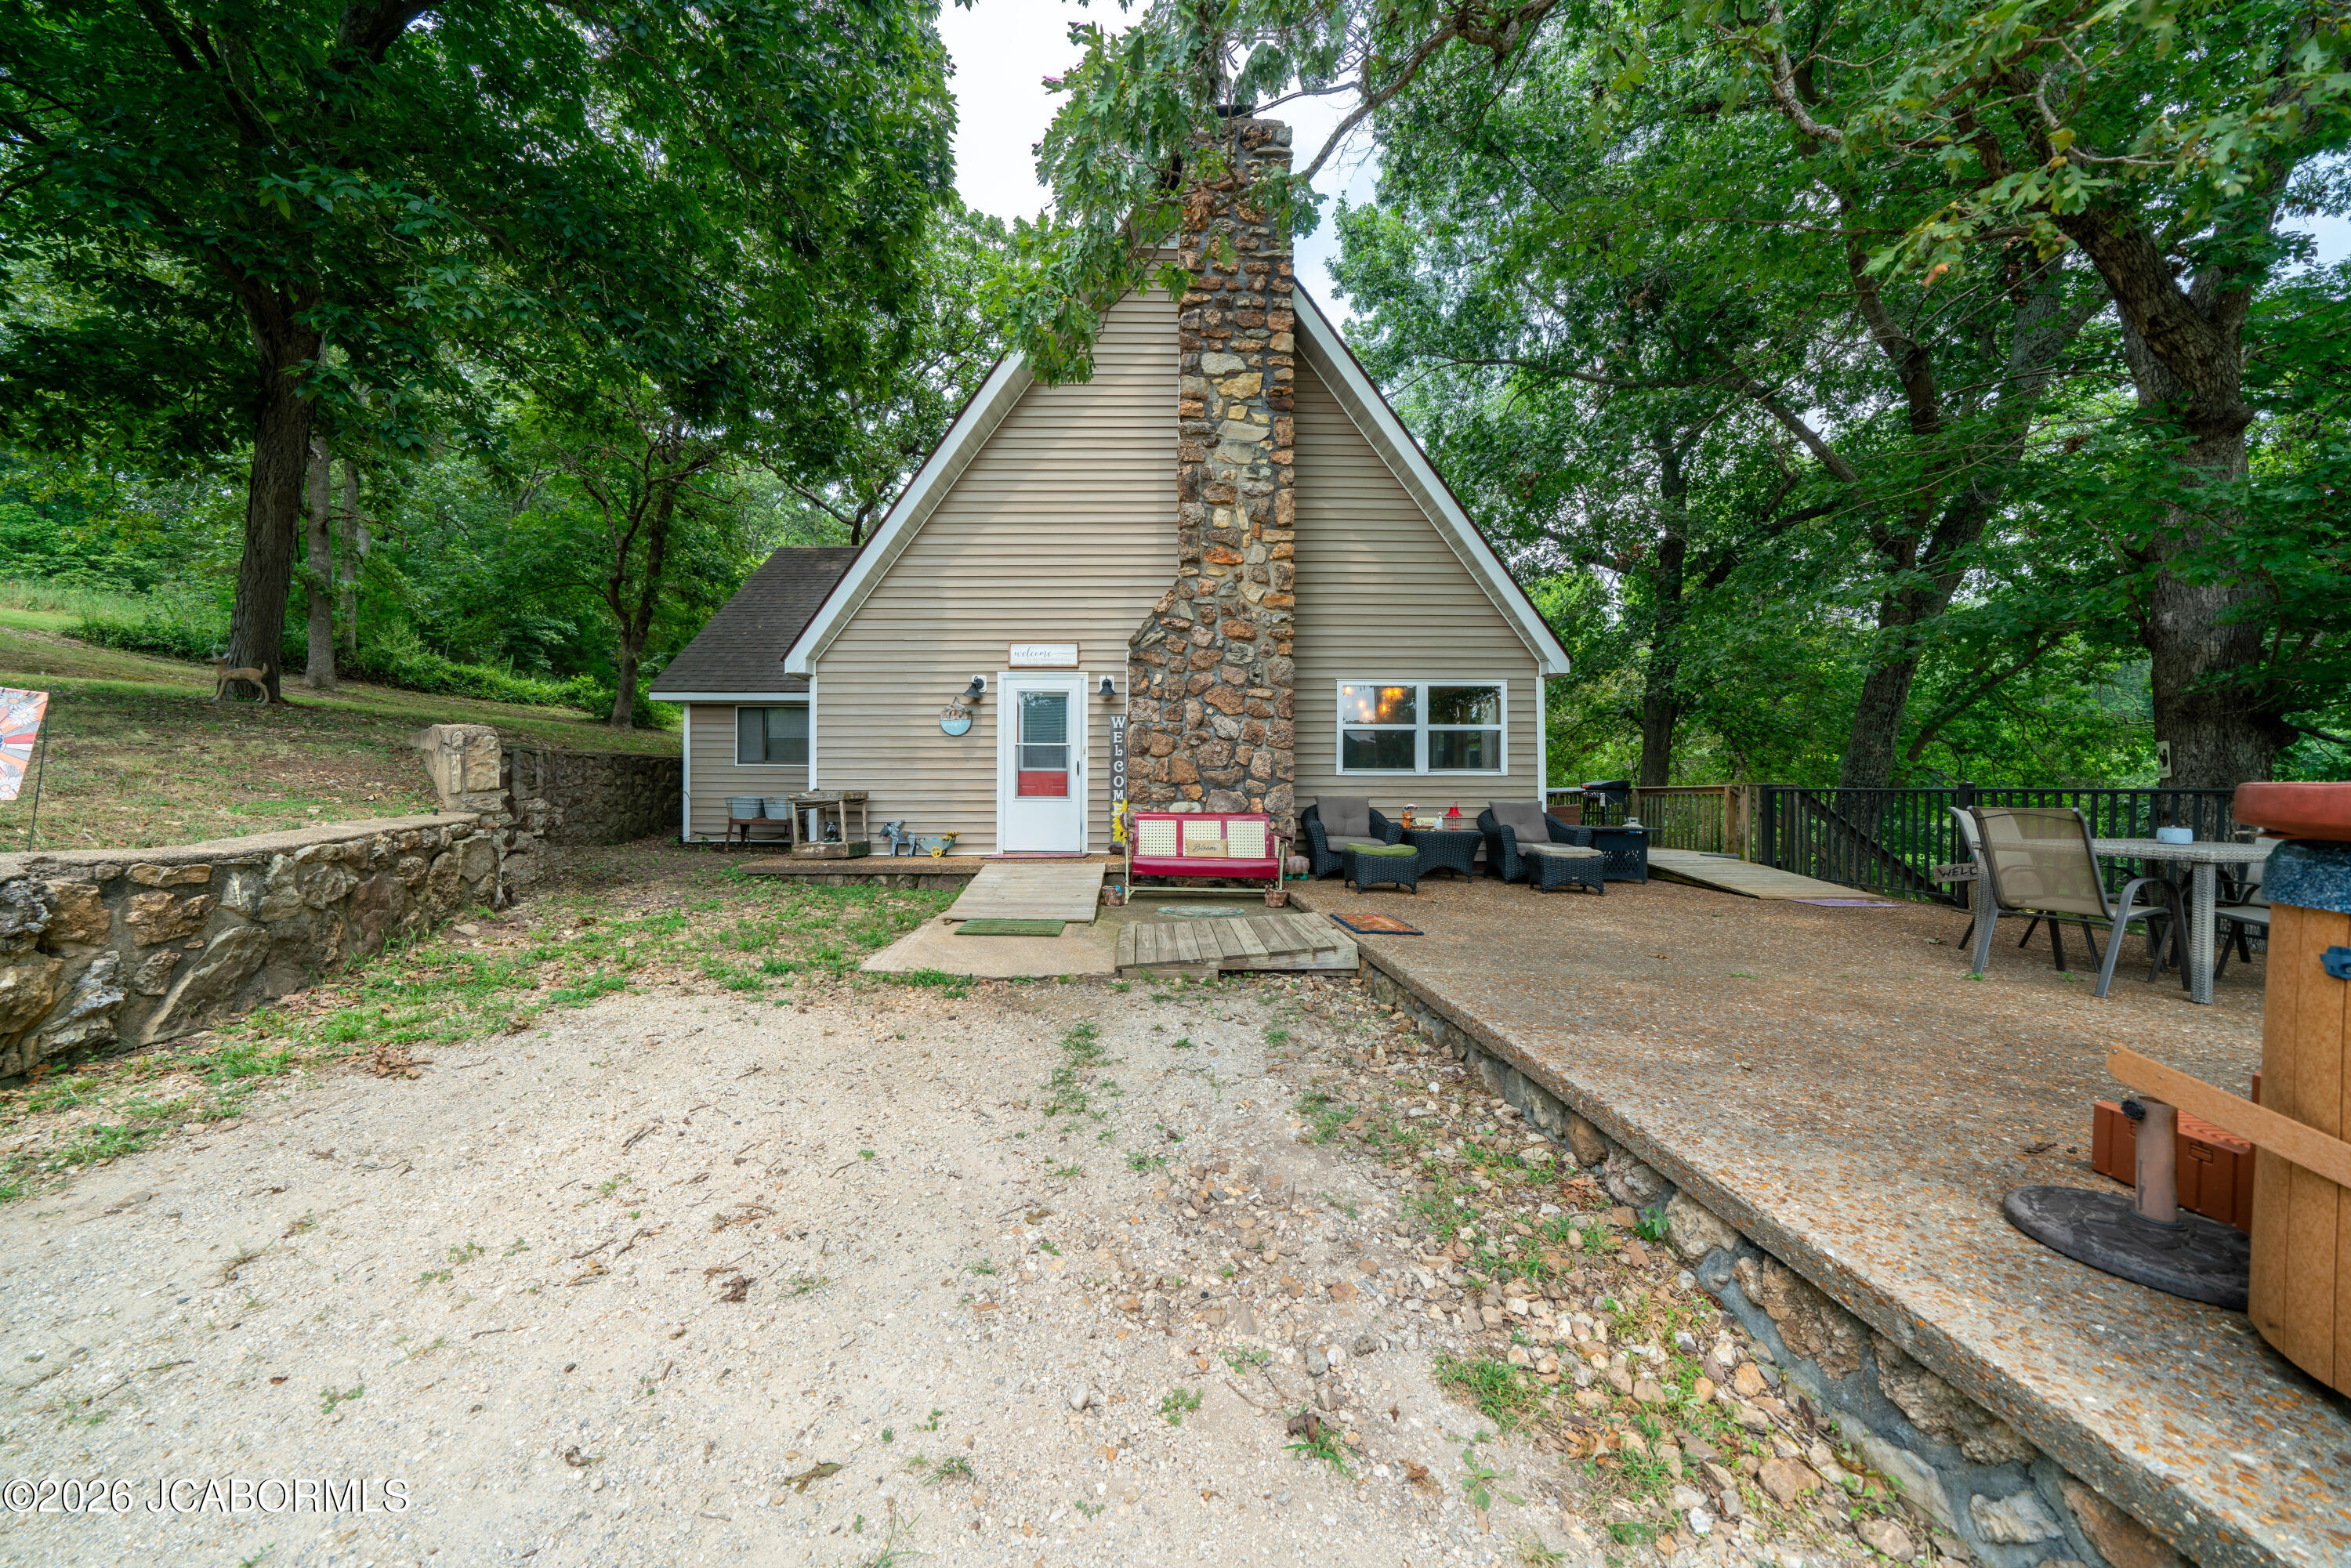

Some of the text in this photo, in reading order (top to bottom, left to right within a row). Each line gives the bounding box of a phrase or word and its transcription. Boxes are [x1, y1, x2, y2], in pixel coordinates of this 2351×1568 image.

[1014, 646, 1051, 657] welcome
[1111, 716, 1126, 816] WELCOME
[1192, 843, 1216, 853] Bloom
